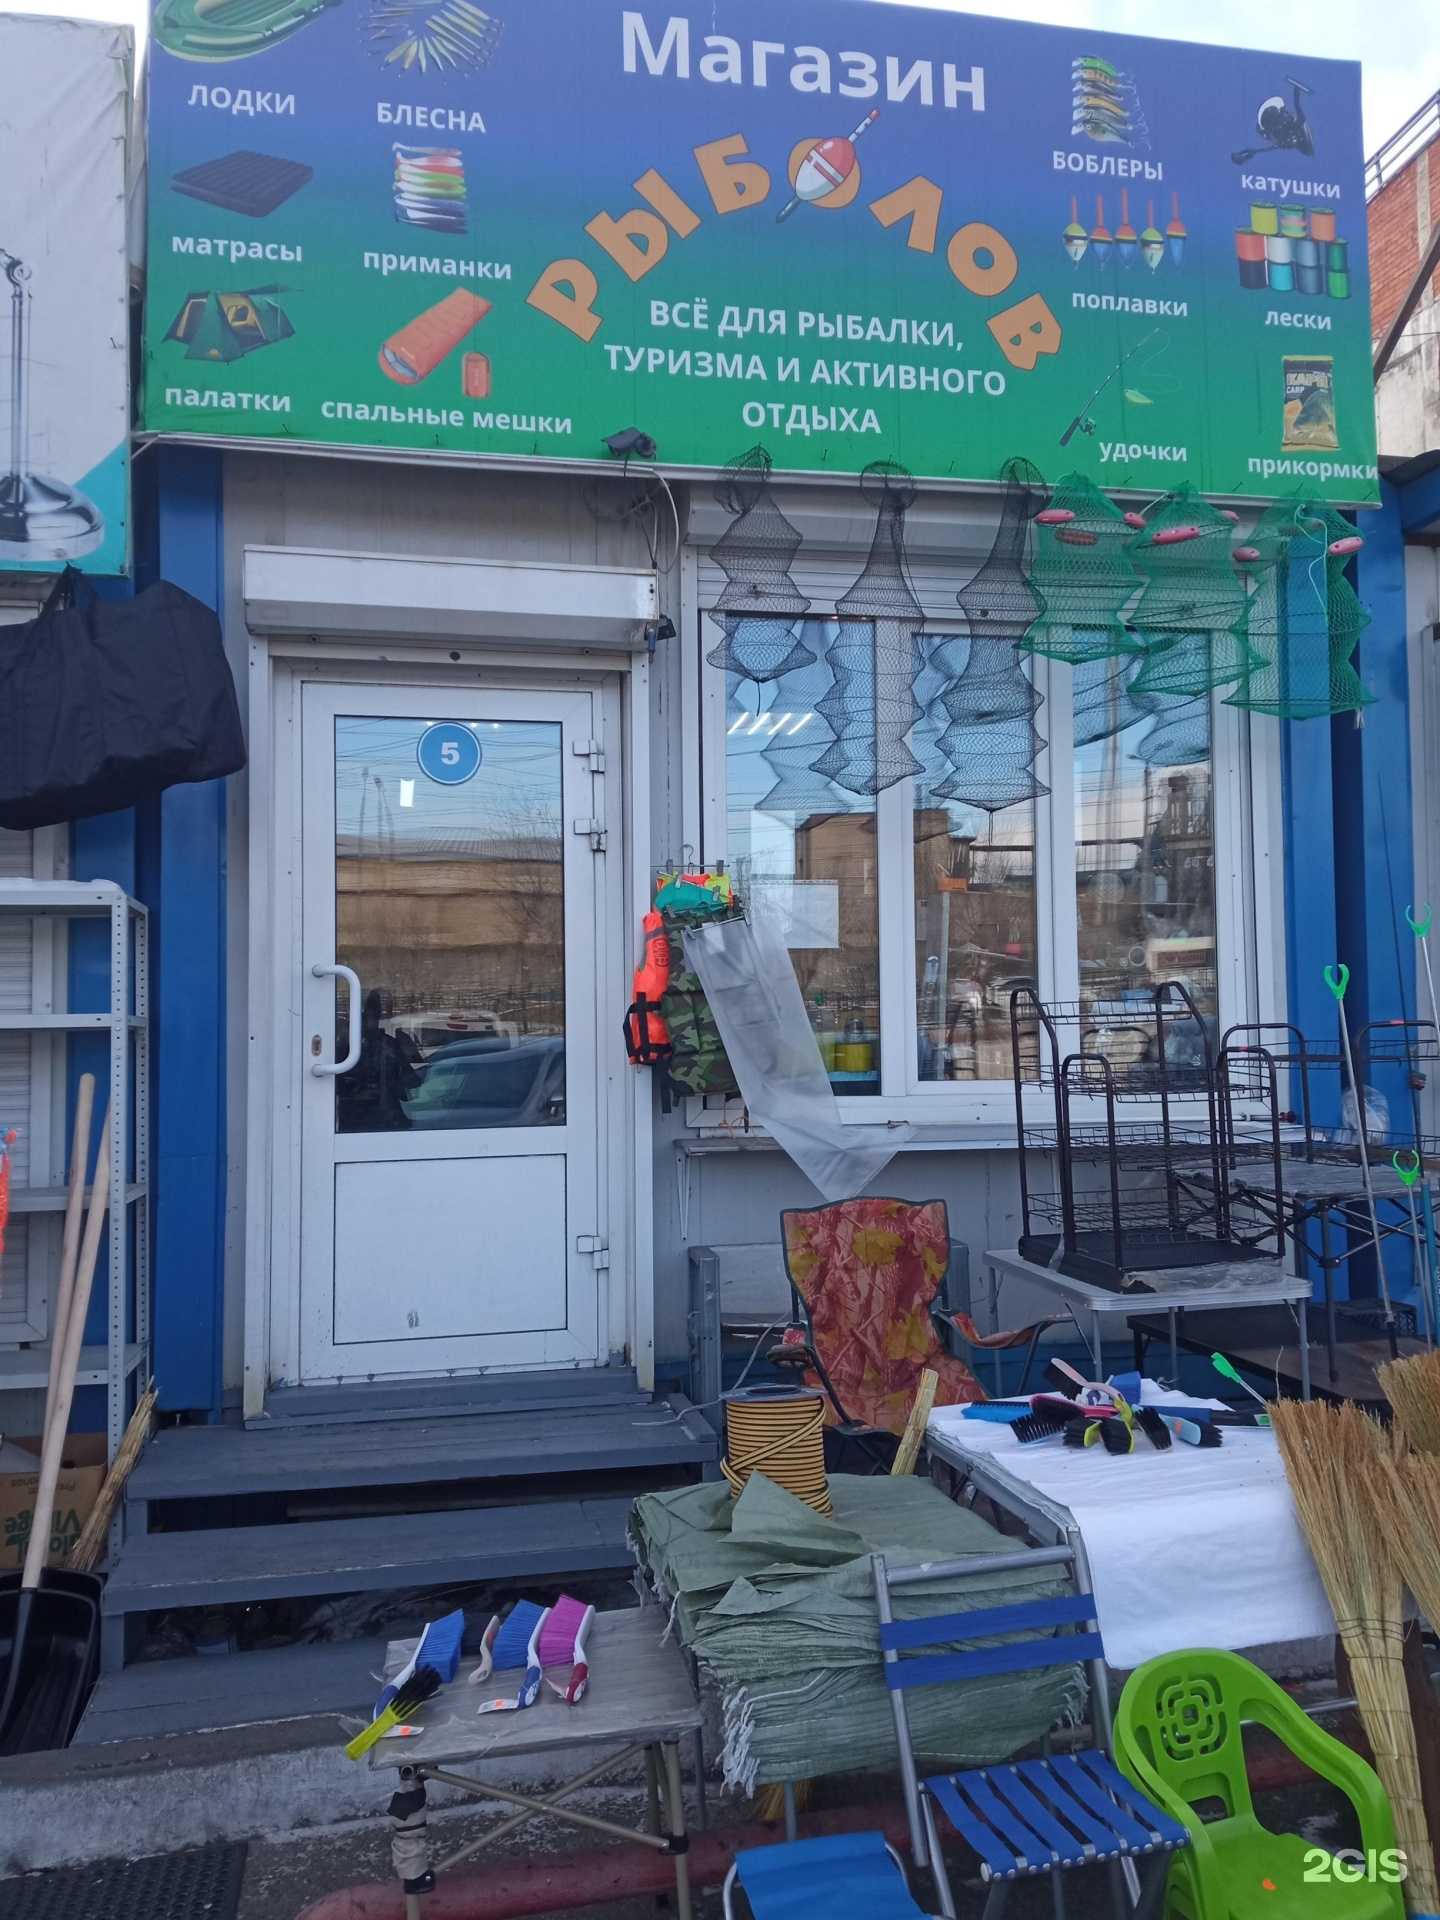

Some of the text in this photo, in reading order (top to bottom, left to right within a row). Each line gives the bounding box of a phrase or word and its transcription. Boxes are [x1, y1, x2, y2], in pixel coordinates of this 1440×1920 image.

[621, 10, 987, 112] Магазин
[187, 84, 296, 117] ЛОДКИ
[376, 102, 487, 134] БЛЕСНА
[1052, 150, 1164, 182] ВОБЛЕРЫ
[1241, 173, 1342, 200] катушки
[172, 236, 303, 264] матрасы
[525, 132, 1062, 371] РЫБОЛОВ
[363, 251, 512, 281] приманки
[1072, 292, 1188, 318] поплавки
[1264, 309, 1333, 332] лески
[650, 297, 964, 352] ВСЁ ДЛЯ РЫБАЛКИ,
[603, 344, 1007, 396] ТУРИЗМА И АКТИВНОГО
[164, 388, 292, 413] палатки
[320, 401, 573, 435] спальные мешки
[741, 401, 882, 438] ОТДЫХА
[1099, 441, 1188, 468] удочки
[1247, 456, 1379, 482] прикормки
[440, 742, 460, 765] 5
